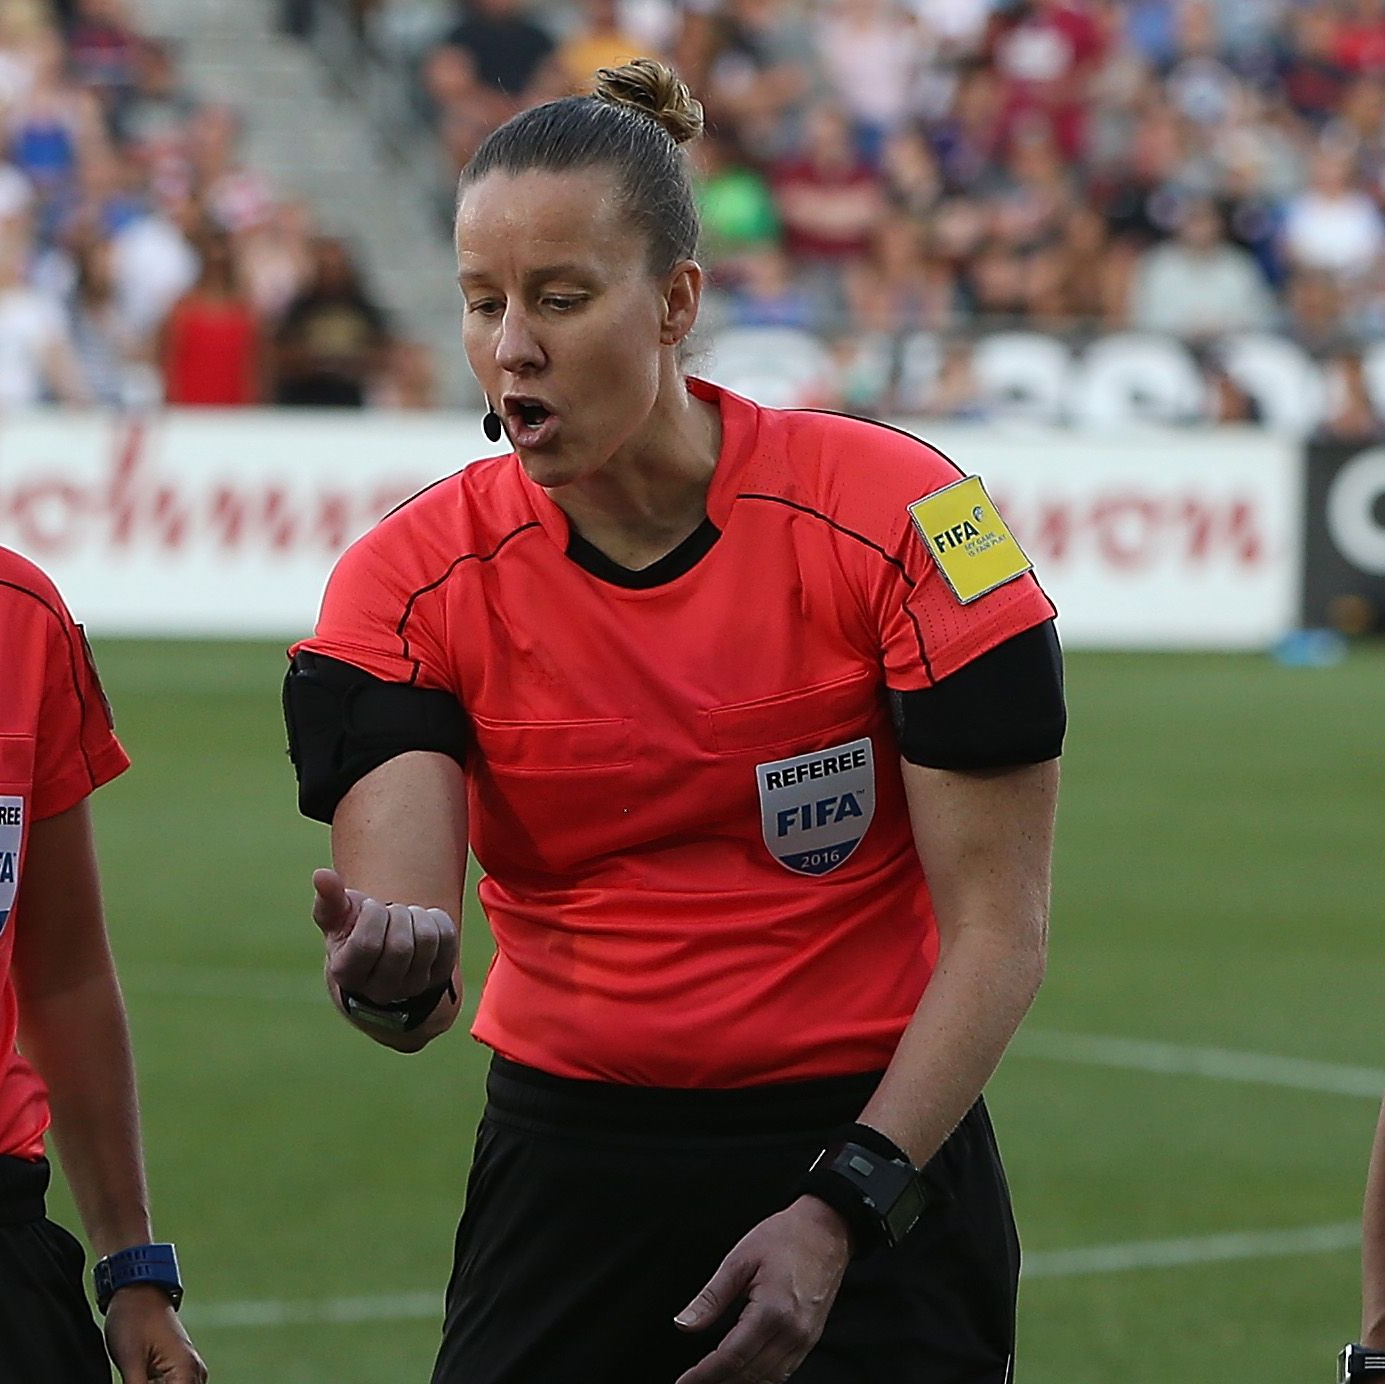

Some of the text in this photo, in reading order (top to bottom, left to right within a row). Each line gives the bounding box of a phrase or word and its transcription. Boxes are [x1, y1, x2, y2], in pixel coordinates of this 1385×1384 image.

[933, 520, 980, 554] FIFA
[766, 748, 866, 791] REFEREE
[777, 791, 863, 838] FIFA
[800, 849, 840, 869] 2016
